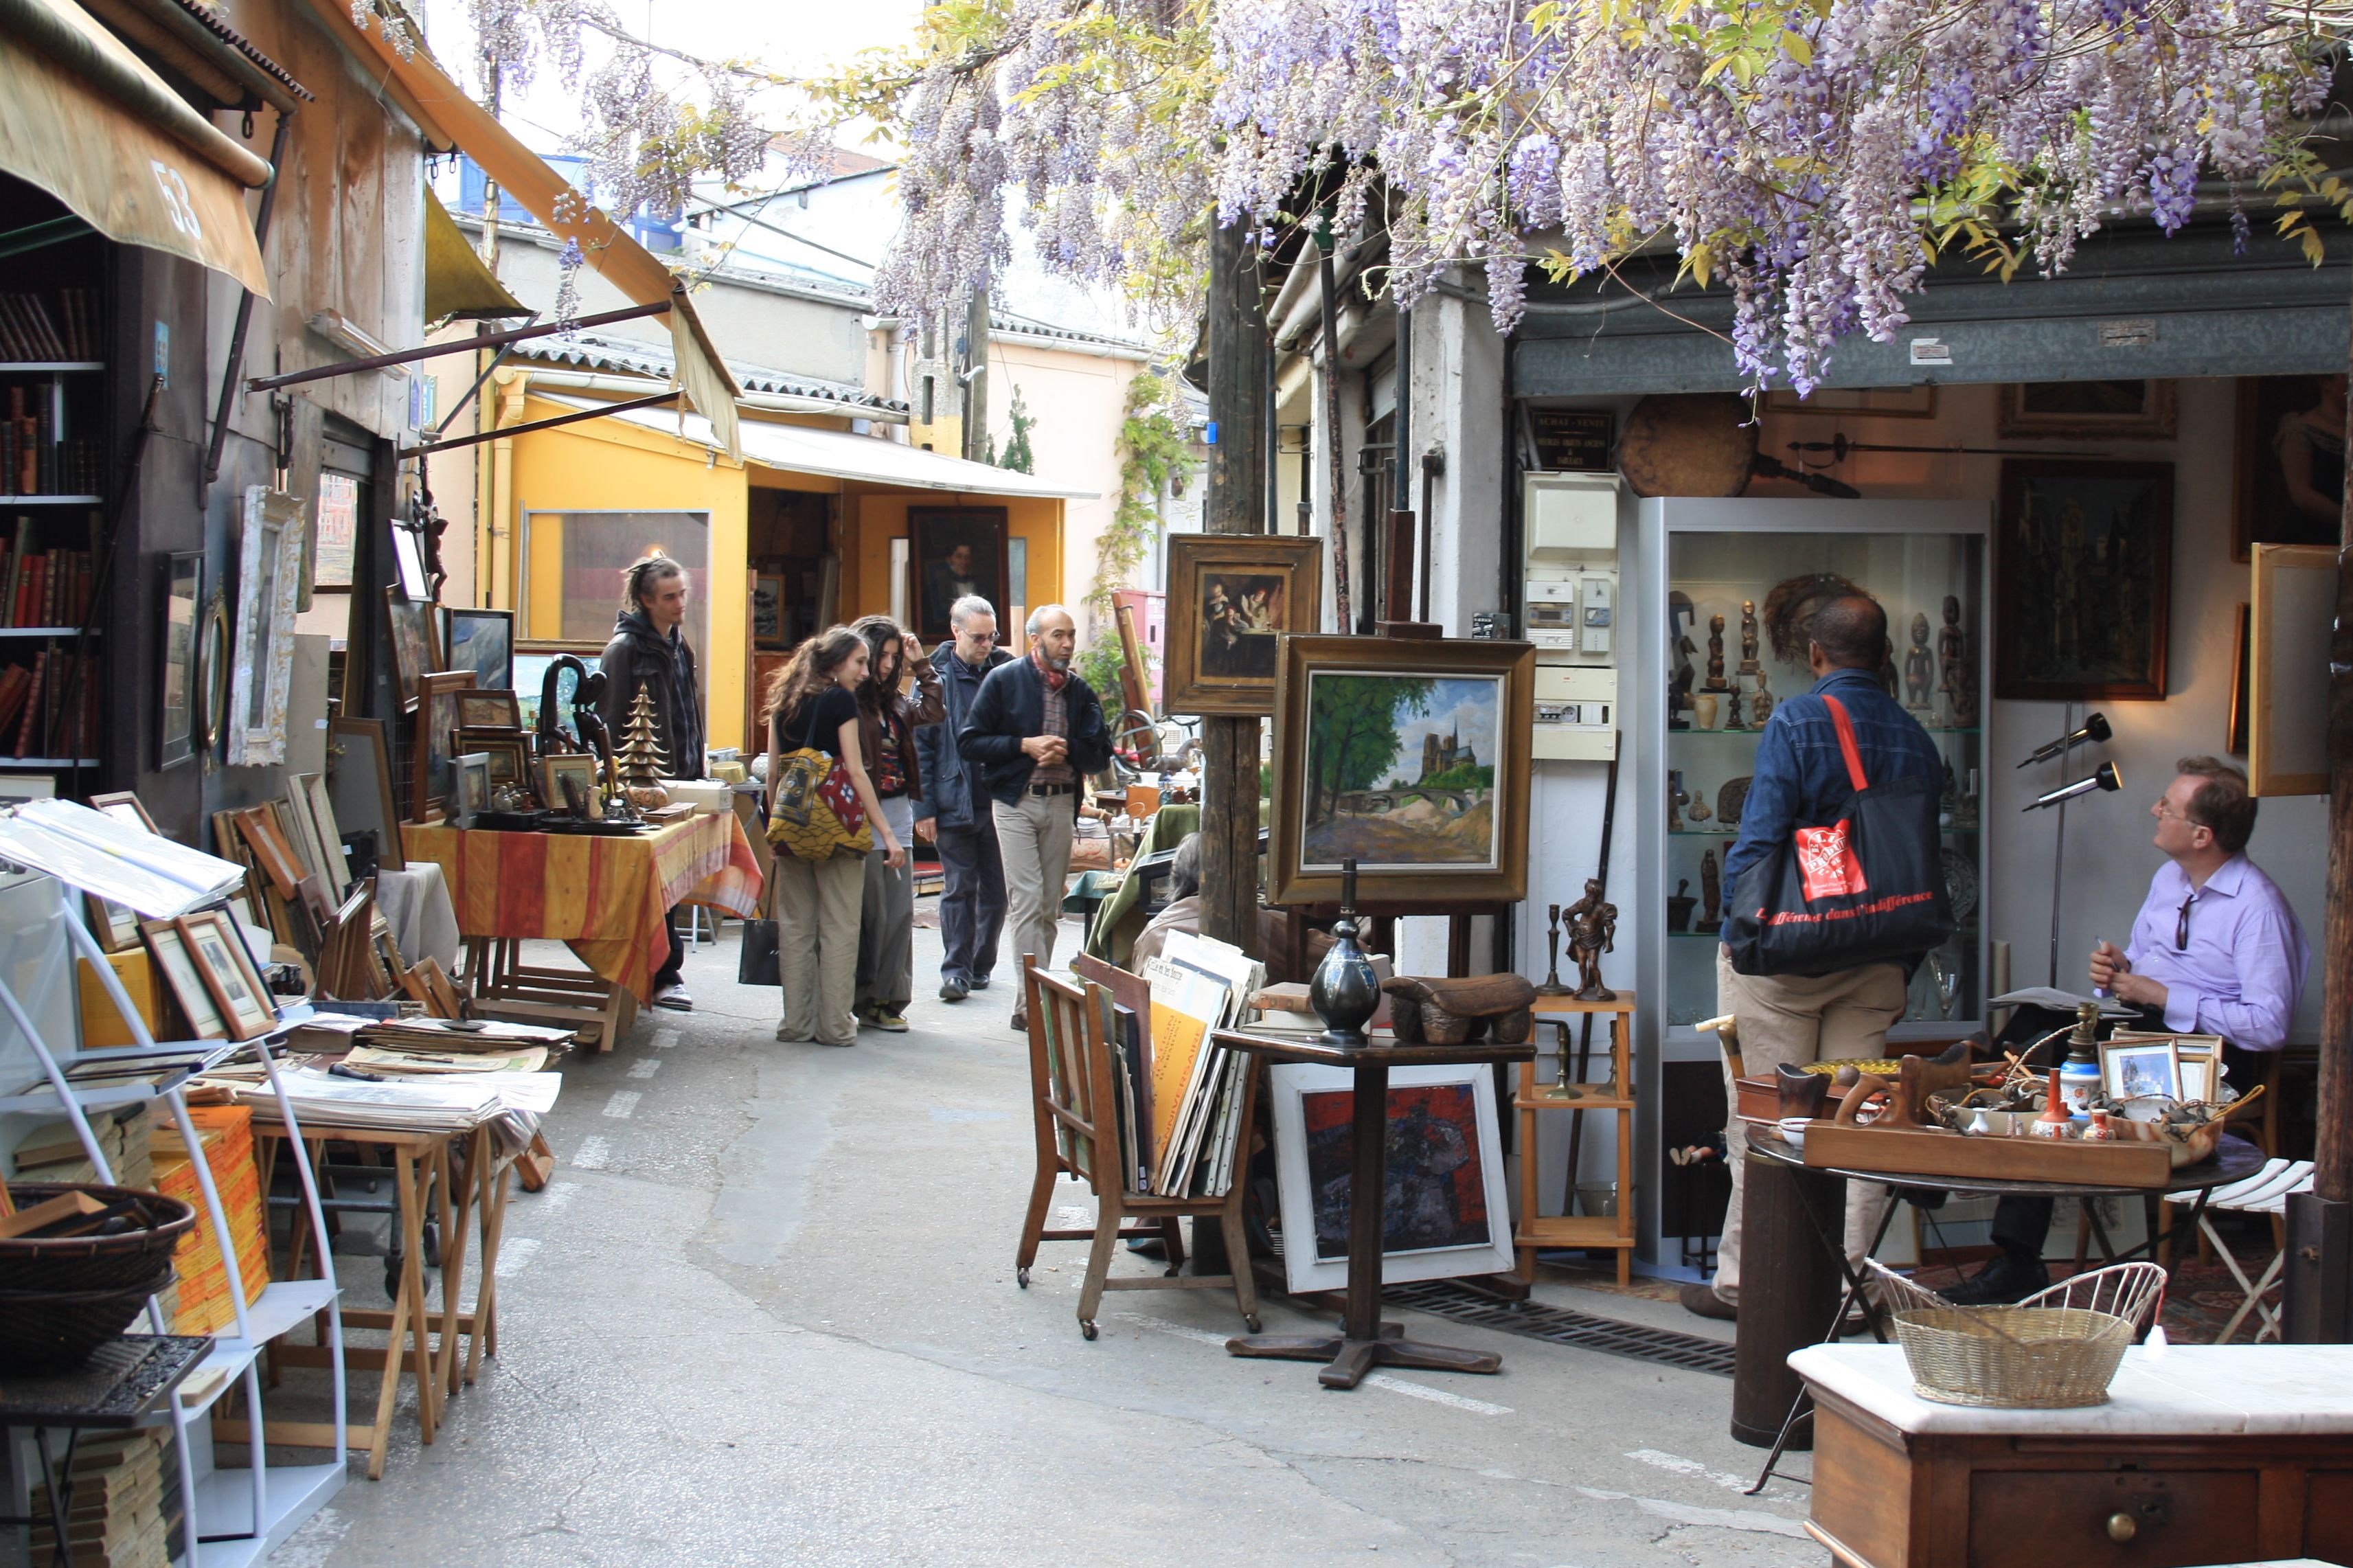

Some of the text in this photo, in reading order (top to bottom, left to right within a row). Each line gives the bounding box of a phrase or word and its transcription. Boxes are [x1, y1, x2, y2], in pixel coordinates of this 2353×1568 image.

[150, 159, 201, 239] 53
[1539, 418, 1569, 427] ACHAT
[1826, 908, 1855, 920] dans
[1856, 891, 1933, 916] l'indifférence
[1161, 1025, 1203, 1151] ANNIVERSAIRE
